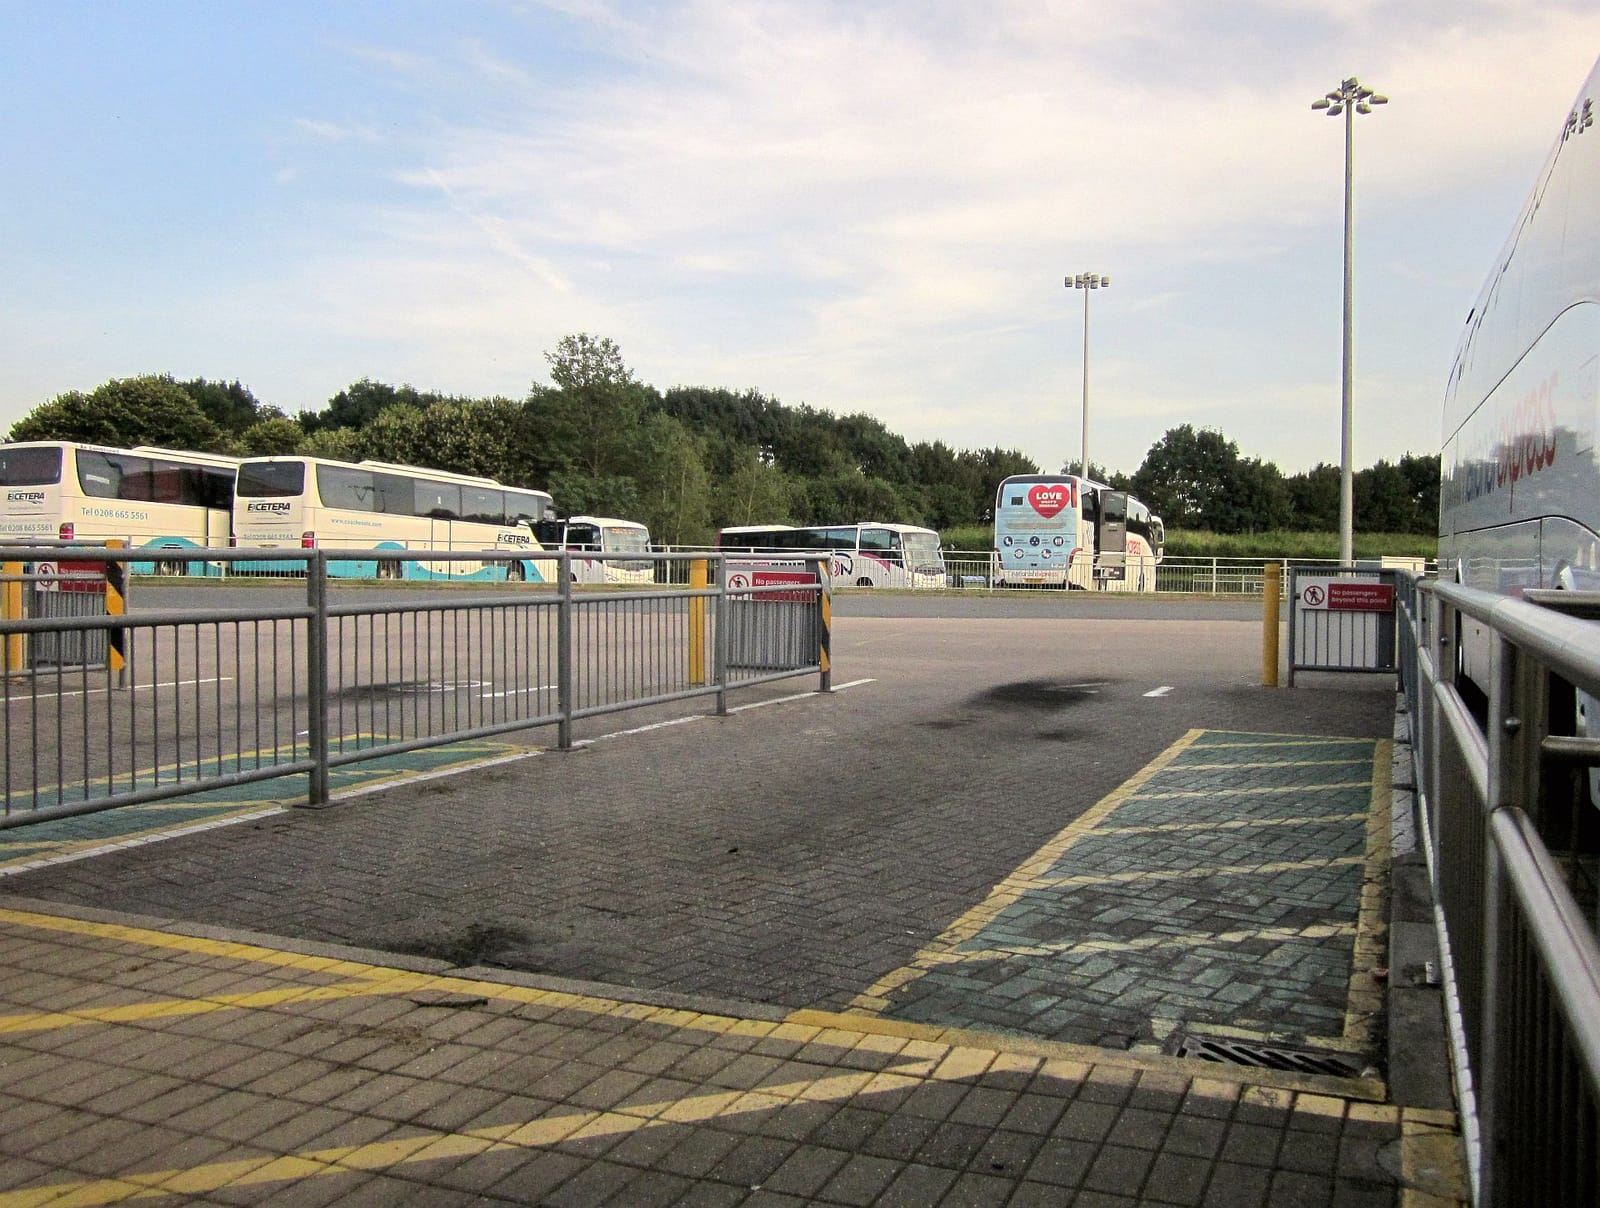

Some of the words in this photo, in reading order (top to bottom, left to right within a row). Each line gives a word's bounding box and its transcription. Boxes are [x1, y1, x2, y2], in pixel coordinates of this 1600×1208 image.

[1036, 491, 1063, 500] LOVE
[82, 507, 93, 516] Tel
[94, 508, 114, 518] 0208
[115, 510, 129, 519] 665
[130, 511, 149, 520] 5561
